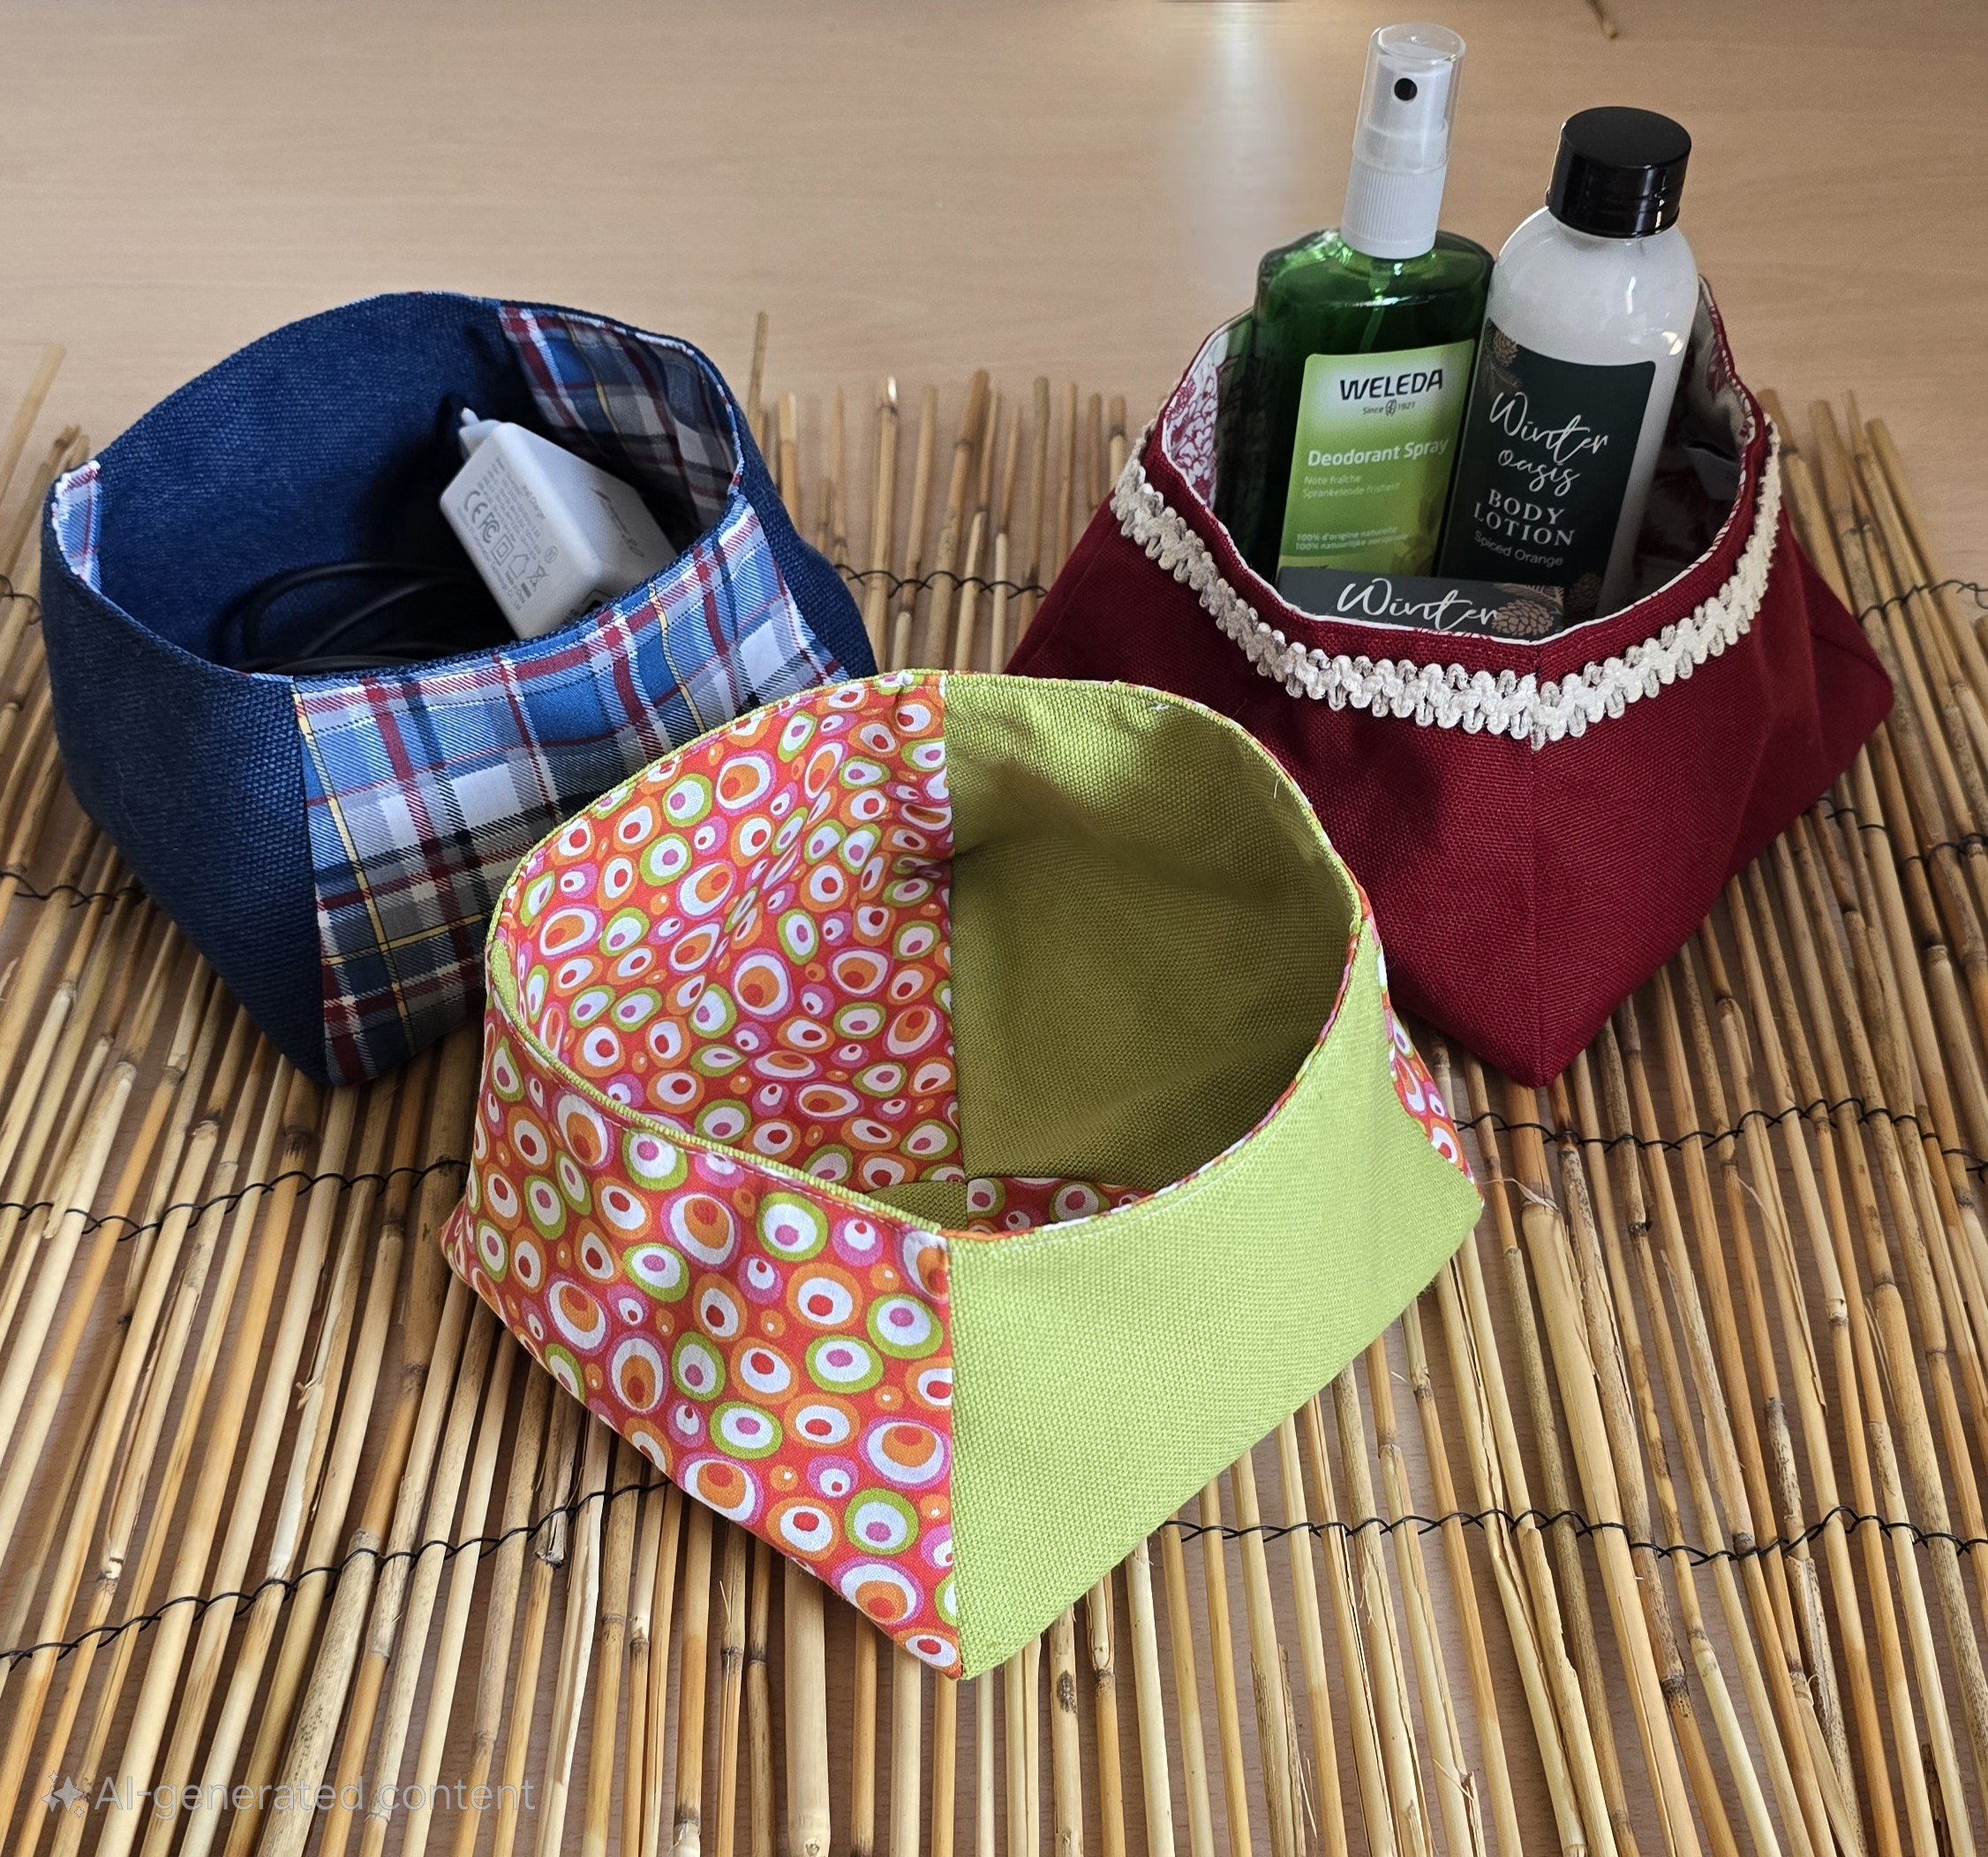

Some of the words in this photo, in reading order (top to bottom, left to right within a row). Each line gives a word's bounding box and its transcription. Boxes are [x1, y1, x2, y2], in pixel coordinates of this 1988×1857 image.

[1340, 369, 1442, 401] WELEDA
[1362, 407, 1384, 416] Since
[1397, 402, 1416, 410] 1921
[1489, 391, 1608, 463] Winter
[1307, 445, 1401, 467] Deodorant
[1403, 439, 1449, 460] Spray
[1473, 502, 1576, 546] LOTION
[1488, 489, 1565, 525] BODY
[1474, 530, 1512, 558] Spiced
[1514, 548, 1564, 568] Orange
[1337, 577, 1498, 630] Winter
